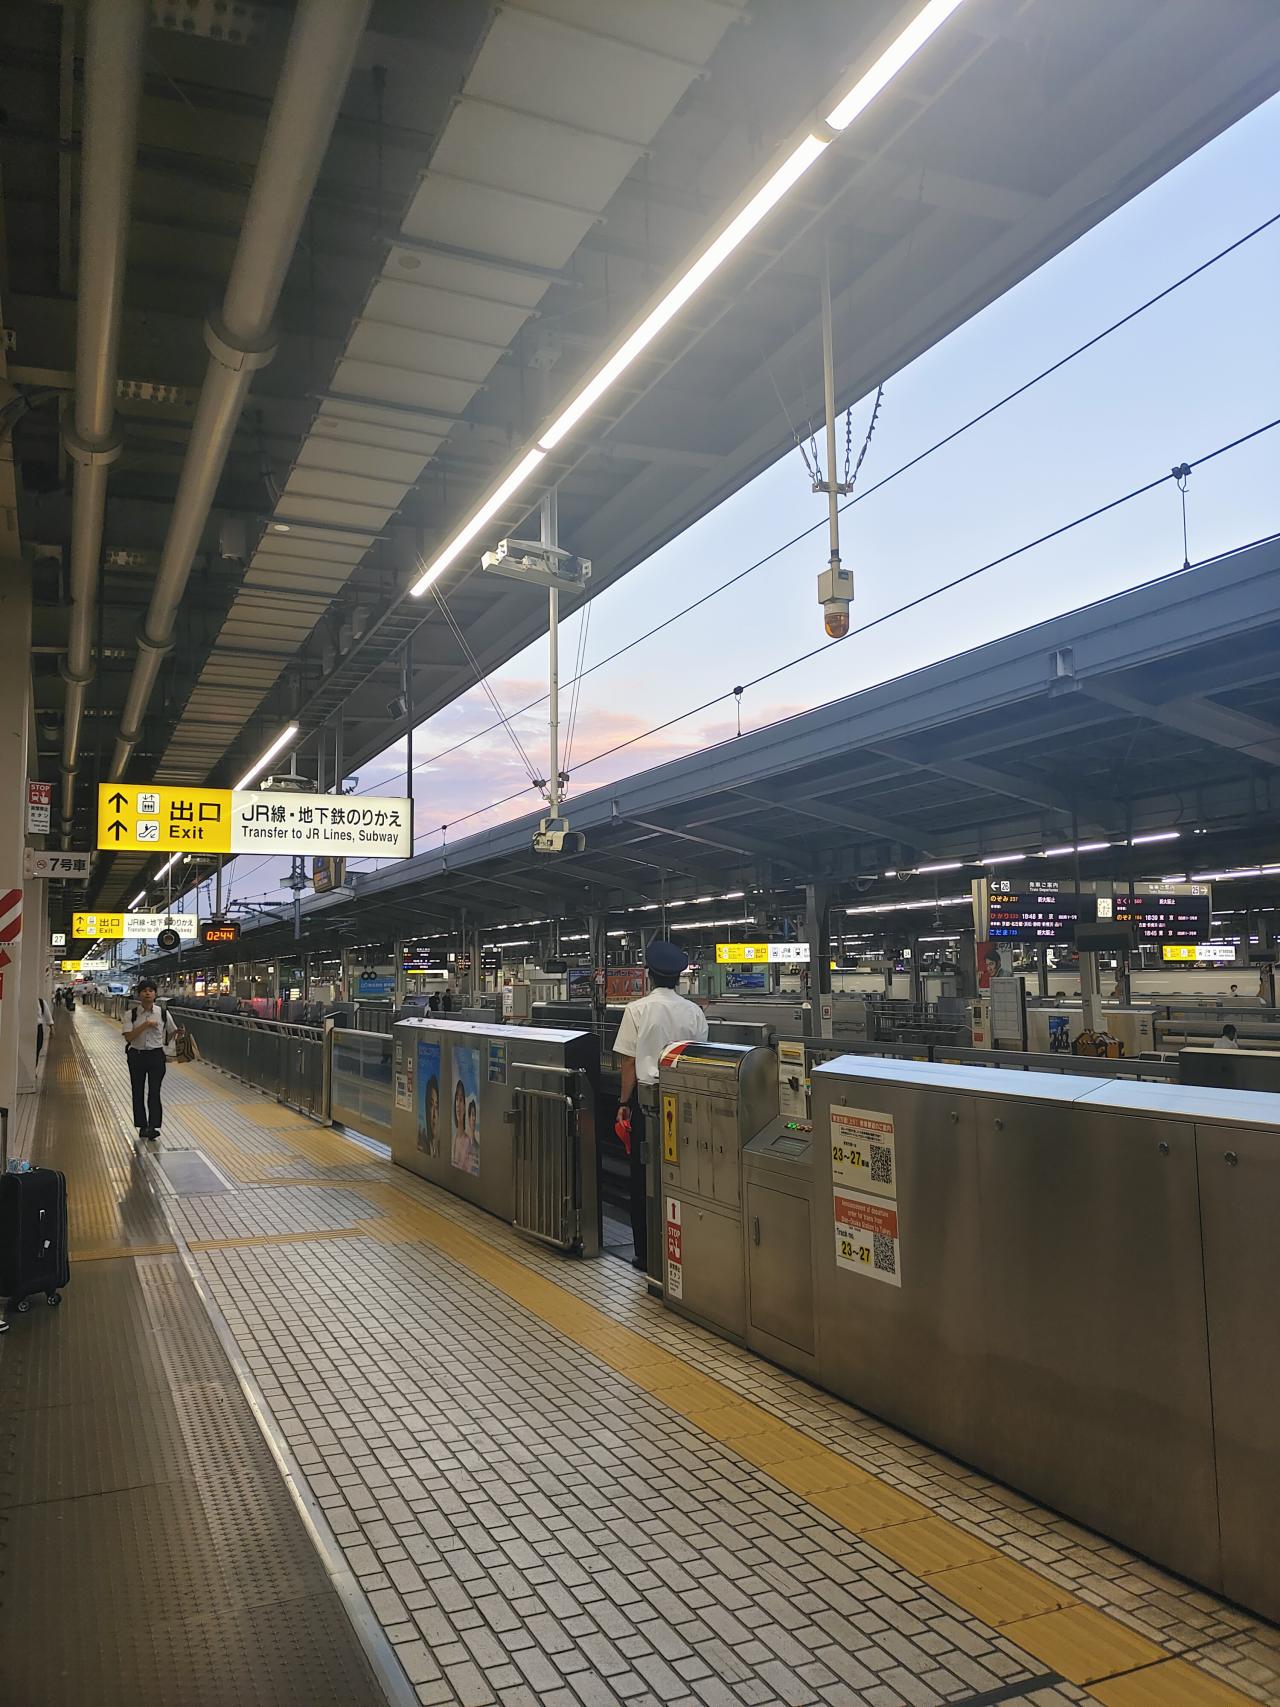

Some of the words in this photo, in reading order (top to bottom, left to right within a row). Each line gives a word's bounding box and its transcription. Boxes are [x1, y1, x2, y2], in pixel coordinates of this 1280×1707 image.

[170, 800, 221, 822] 出口
[242, 804, 401, 827] JR線・地下鉄のりかえ
[170, 826, 204, 839] Exit
[242, 826, 288, 839] Transfer
[292, 828, 302, 839] to
[306, 828, 319, 840] JR
[324, 828, 355, 842] Lines,
[358, 830, 398, 845] Subway
[50, 858, 86, 871] 7号車
[206, 932, 233, 940] 0244
[668, 1227, 680, 1238] STOP
[836, 1227, 847, 1236] Track
